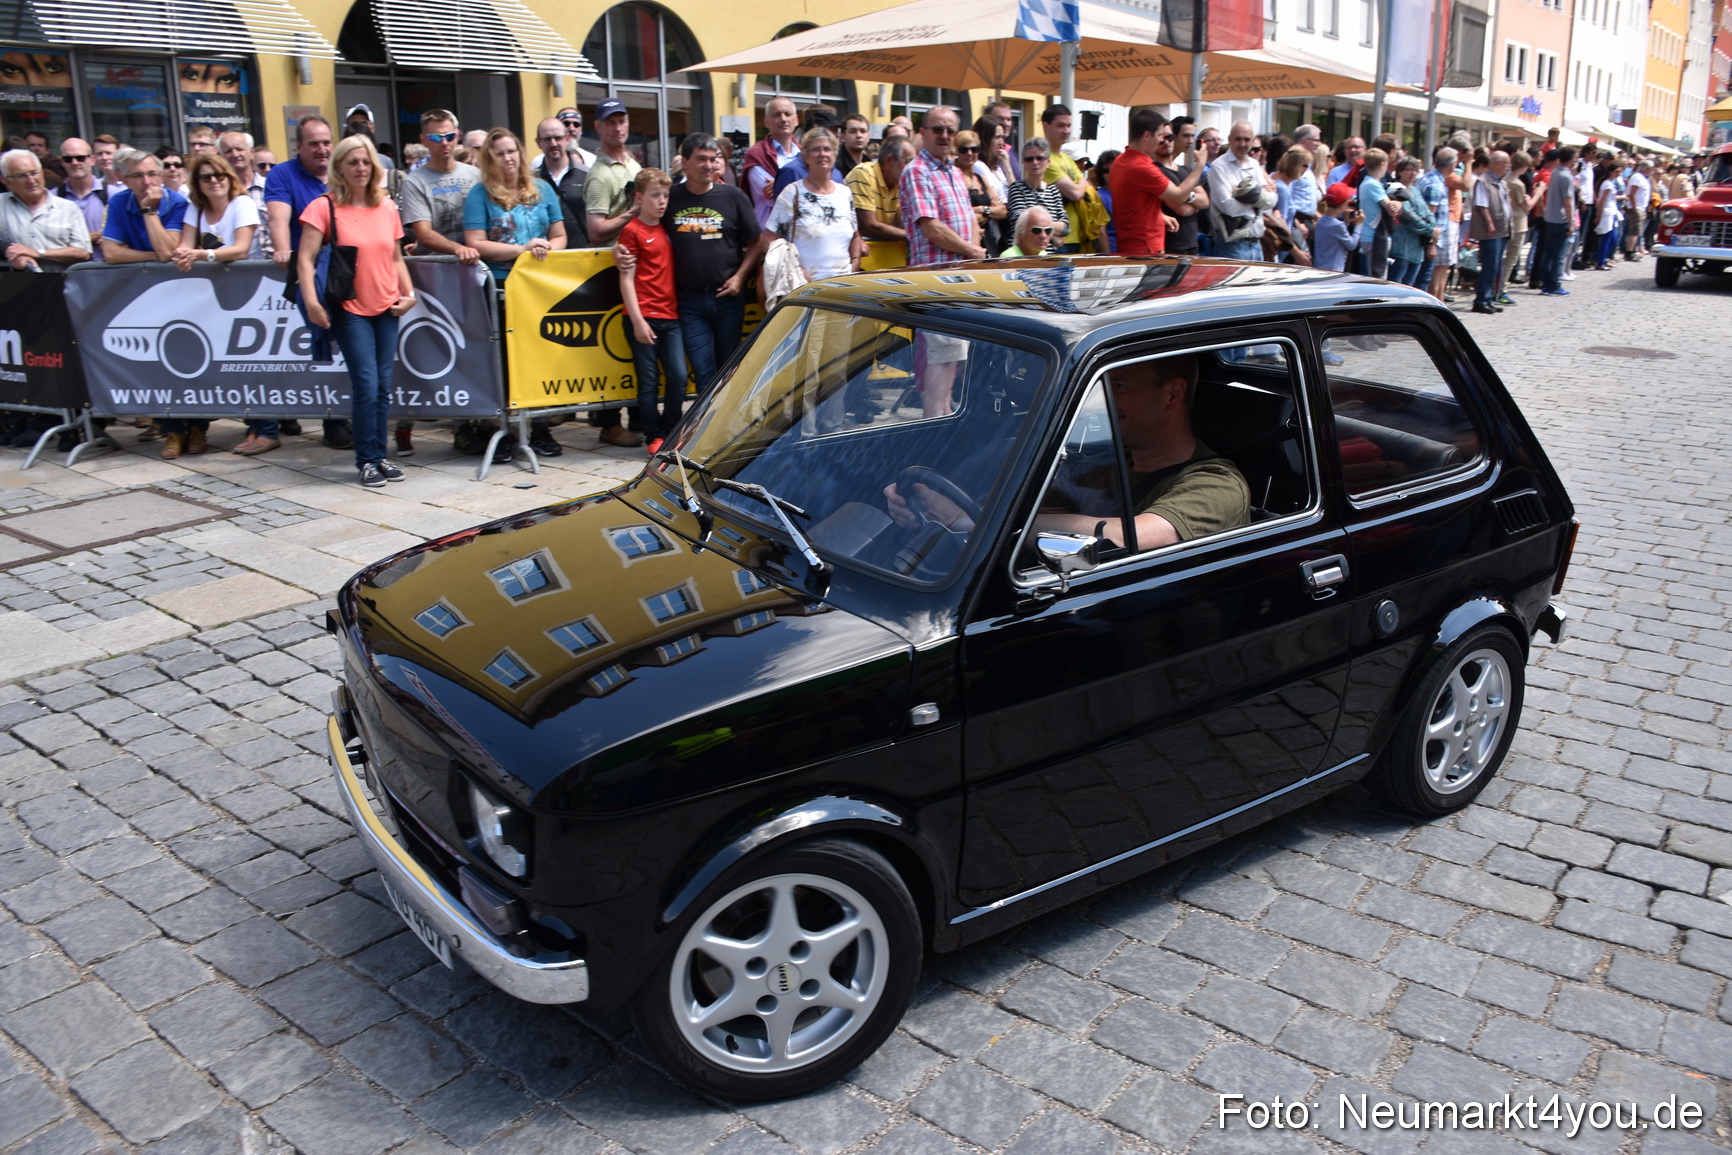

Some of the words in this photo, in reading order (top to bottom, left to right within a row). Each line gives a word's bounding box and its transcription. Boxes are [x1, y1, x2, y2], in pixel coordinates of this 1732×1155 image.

[36, 94, 64, 103] Bilder
[196, 100, 237, 109] Passbilder
[225, 317, 340, 356] Die
[24, 351, 63, 368] GmbH
[220, 363, 308, 373] BREITENBRUNN
[110, 384, 470, 407] www.autoklassik-tz.de
